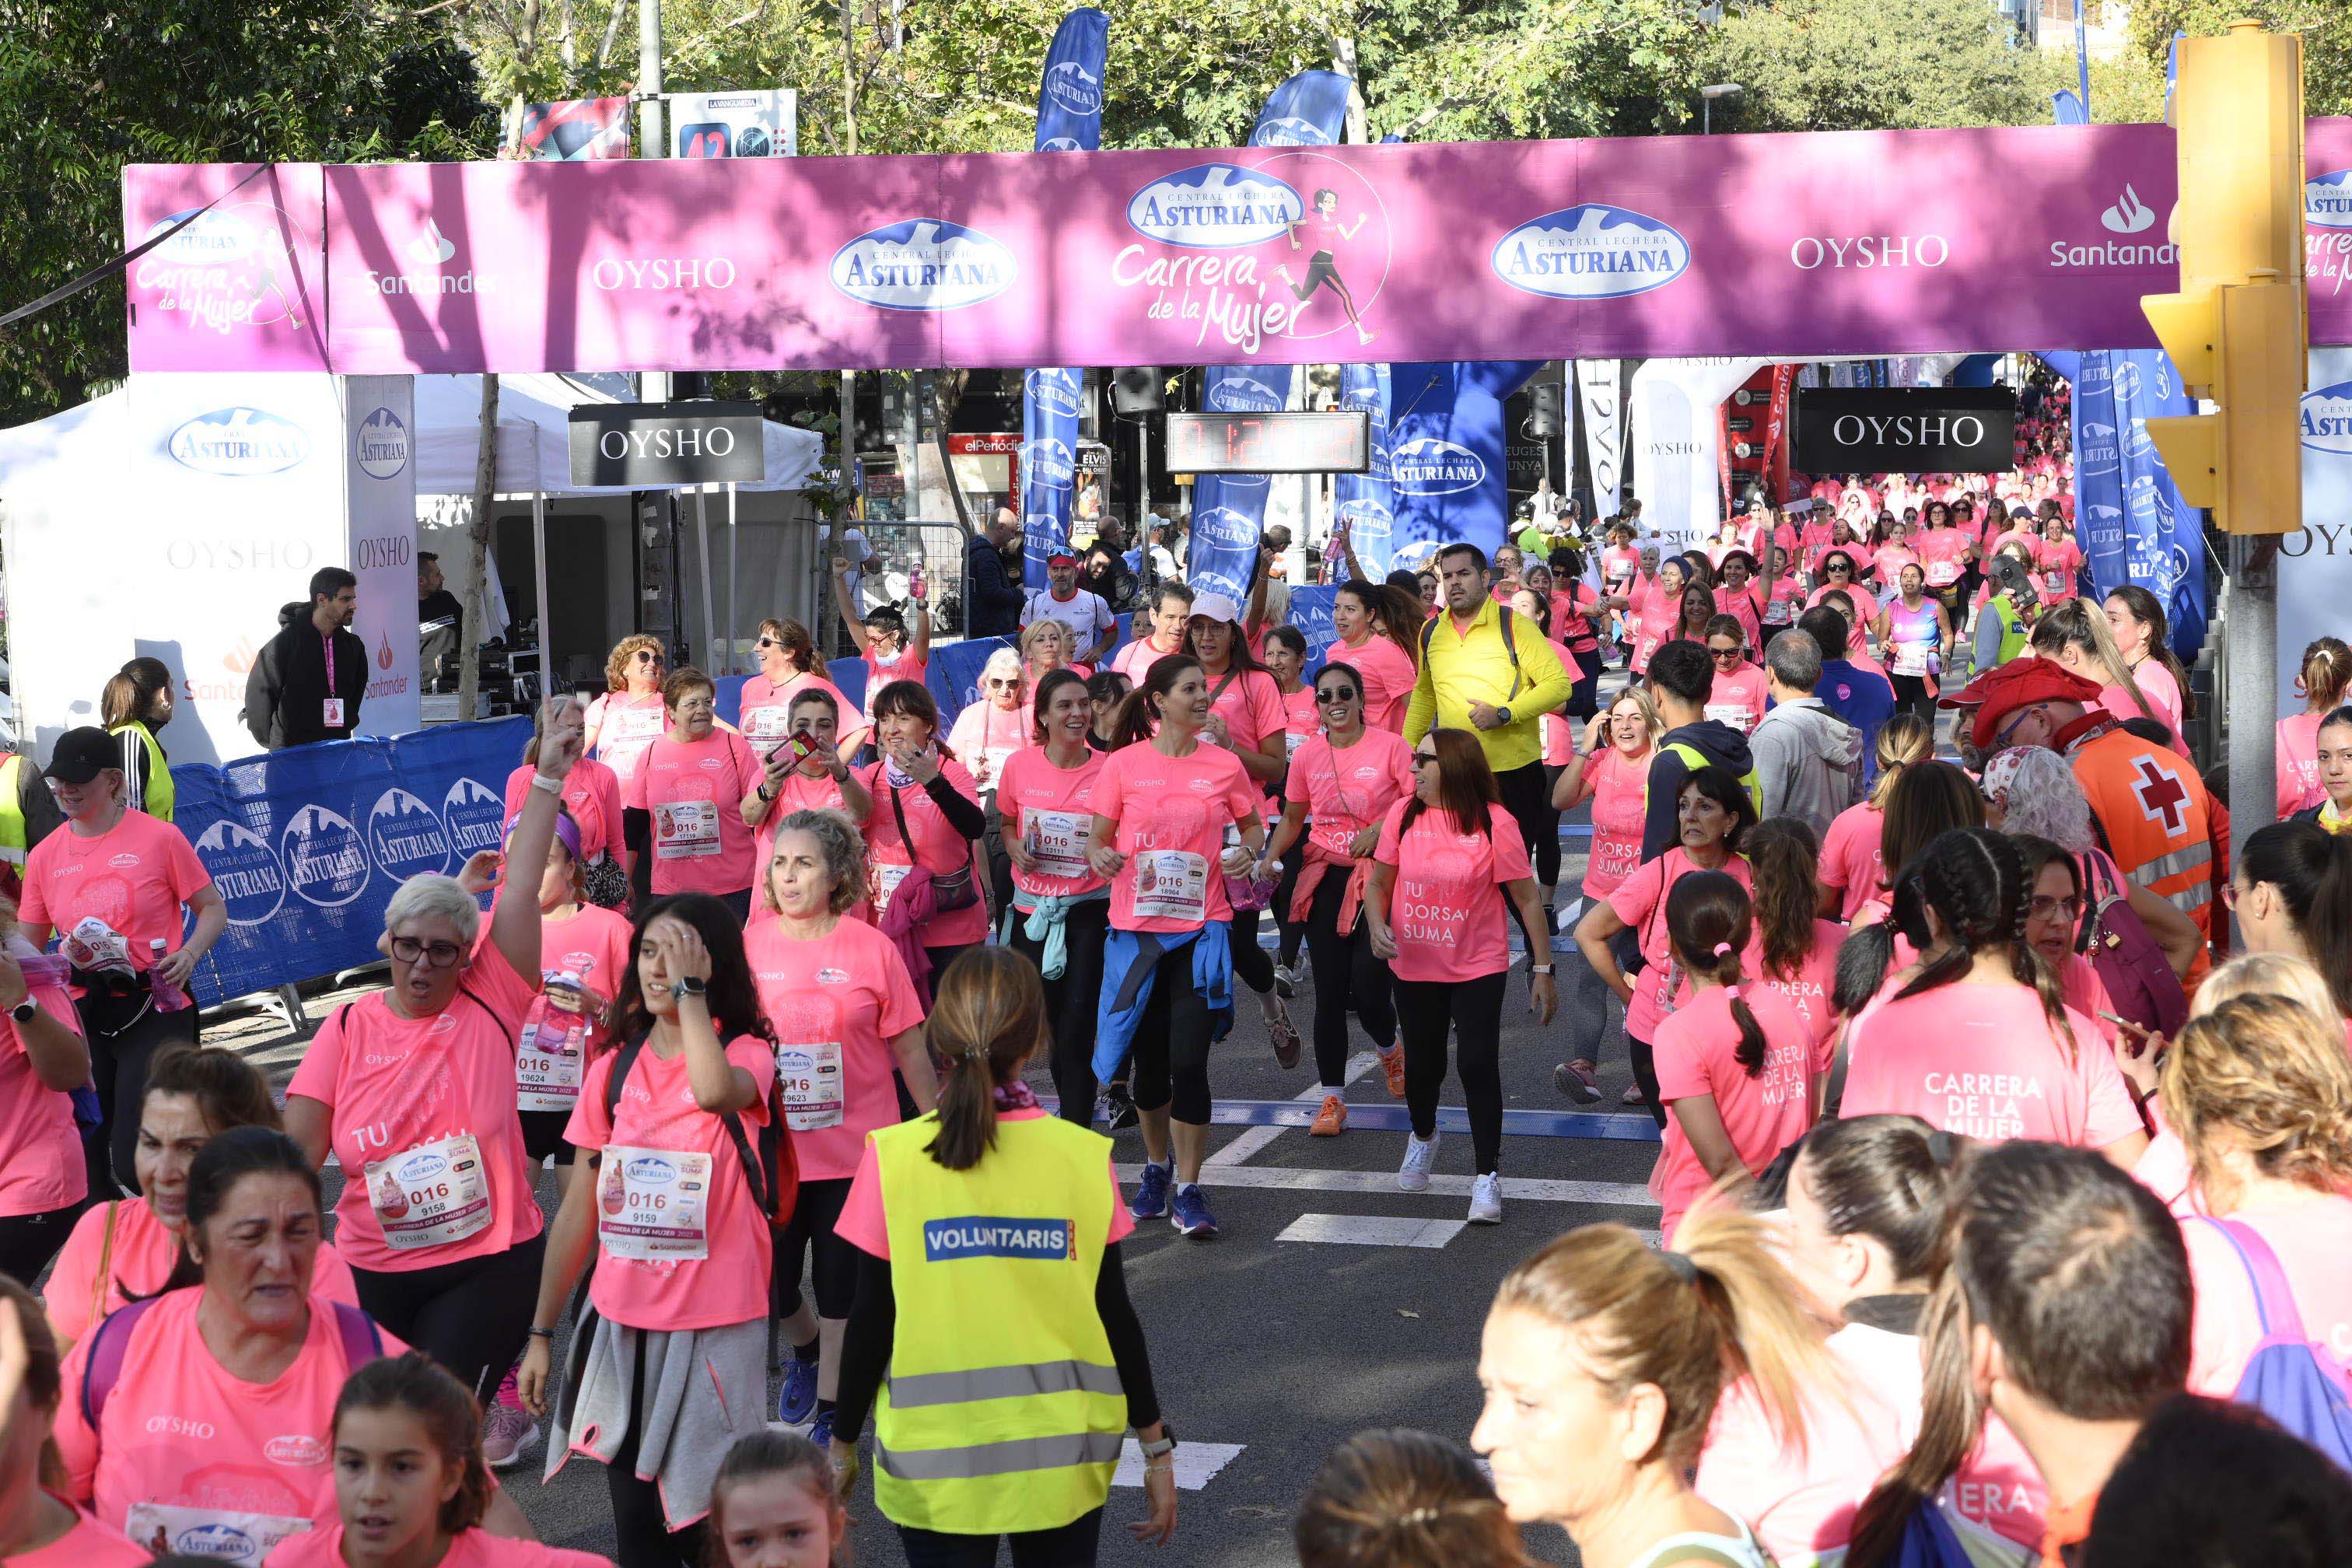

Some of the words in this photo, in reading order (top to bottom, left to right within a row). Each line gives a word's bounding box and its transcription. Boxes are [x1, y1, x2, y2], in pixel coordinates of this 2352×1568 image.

[717, 99, 756, 108] VANGUARDIA
[1167, 192, 1223, 202] CENTRAL
[1228, 191, 1286, 201] LECHERA
[1141, 196, 1290, 227] ASTURIANA
[1537, 236, 1598, 248] CENTRAL
[1605, 236, 1669, 247] LECHERA
[2305, 233, 2352, 256] arre
[872, 250, 930, 261] CENTRAL
[1507, 241, 1675, 276] ASTURIANA
[1790, 235, 1948, 270] OYSHO
[845, 254, 1000, 288] ASTURIANA
[1112, 243, 1258, 287] Carrera
[2324, 255, 2337, 278] la
[364, 270, 498, 295] Santander
[593, 258, 735, 291] OYSHO
[159, 292, 176, 310] de
[1147, 289, 1174, 320] de
[1181, 289, 1200, 320] la
[1196, 276, 1312, 355] Mujer
[1833, 415, 1984, 447] OYSHO
[361, 434, 406, 462] ASTURIANA
[600, 427, 735, 460] OYSHO
[1643, 441, 1702, 456] OYSHO
[1083, 454, 1107, 464] ELVIS
[1391, 461, 1479, 483] ASTURIANA
[1667, 530, 1703, 544] SHO
[166, 537, 313, 571] OYSHO
[358, 535, 410, 571] OYSHO
[365, 675, 411, 701] Santander
[655, 762, 678, 772] OYSHO
[1134, 779, 1165, 787] OYSHO
[1025, 789, 1054, 798] OYSHO
[384, 821, 411, 834] CENTRAL
[450, 815, 505, 851] ASTURIAN
[677, 823, 698, 832] 016
[1594, 821, 1608, 837] TU
[376, 828, 447, 865] ASTURIANA
[1044, 835, 1068, 847] 016
[1133, 833, 1155, 848] TU
[54, 863, 83, 879] OYSHO
[1597, 856, 1636, 874] SUMA
[214, 865, 282, 901] STURIANA
[1020, 877, 1071, 897] SUMA
[1159, 877, 1183, 887] 016
[1405, 880, 1423, 898] TU
[1403, 924, 1457, 943] SUMA
[91, 940, 111, 951] 016
[518, 1058, 550, 1072] 016
[1762, 1044, 1807, 1068] ARRERA
[521, 1073, 545, 1083] 19624
[1764, 1069, 1781, 1087] DE
[1783, 1068, 1801, 1082] LA
[1924, 1072, 2042, 1099] CARRERA
[543, 1098, 572, 1107] Santander
[782, 1094, 807, 1103] 19623
[1761, 1082, 1806, 1107] MUJER
[1948, 1095, 1979, 1117] DE
[1990, 1097, 2021, 1119] LA
[352, 1122, 389, 1152] TU
[1944, 1117, 2025, 1139] MUJER
[449, 1150, 471, 1159] SUMA
[402, 1161, 445, 1179] ASTURIANA
[629, 1167, 673, 1178] ASTURIANA
[681, 1167, 703, 1175] SUMA
[410, 1183, 450, 1205] 016
[628, 1192, 667, 1209] 016
[421, 1202, 446, 1216] 9158
[633, 1213, 657, 1223] 9159
[394, 1221, 425, 1231] CARRERA
[444, 1209, 467, 1221] MUJER
[395, 1234, 429, 1243] OYSHO
[659, 1243, 698, 1251] Santander
[927, 1227, 1066, 1251] VOLUNTARIS
[145, 1415, 215, 1440] OYSHO
